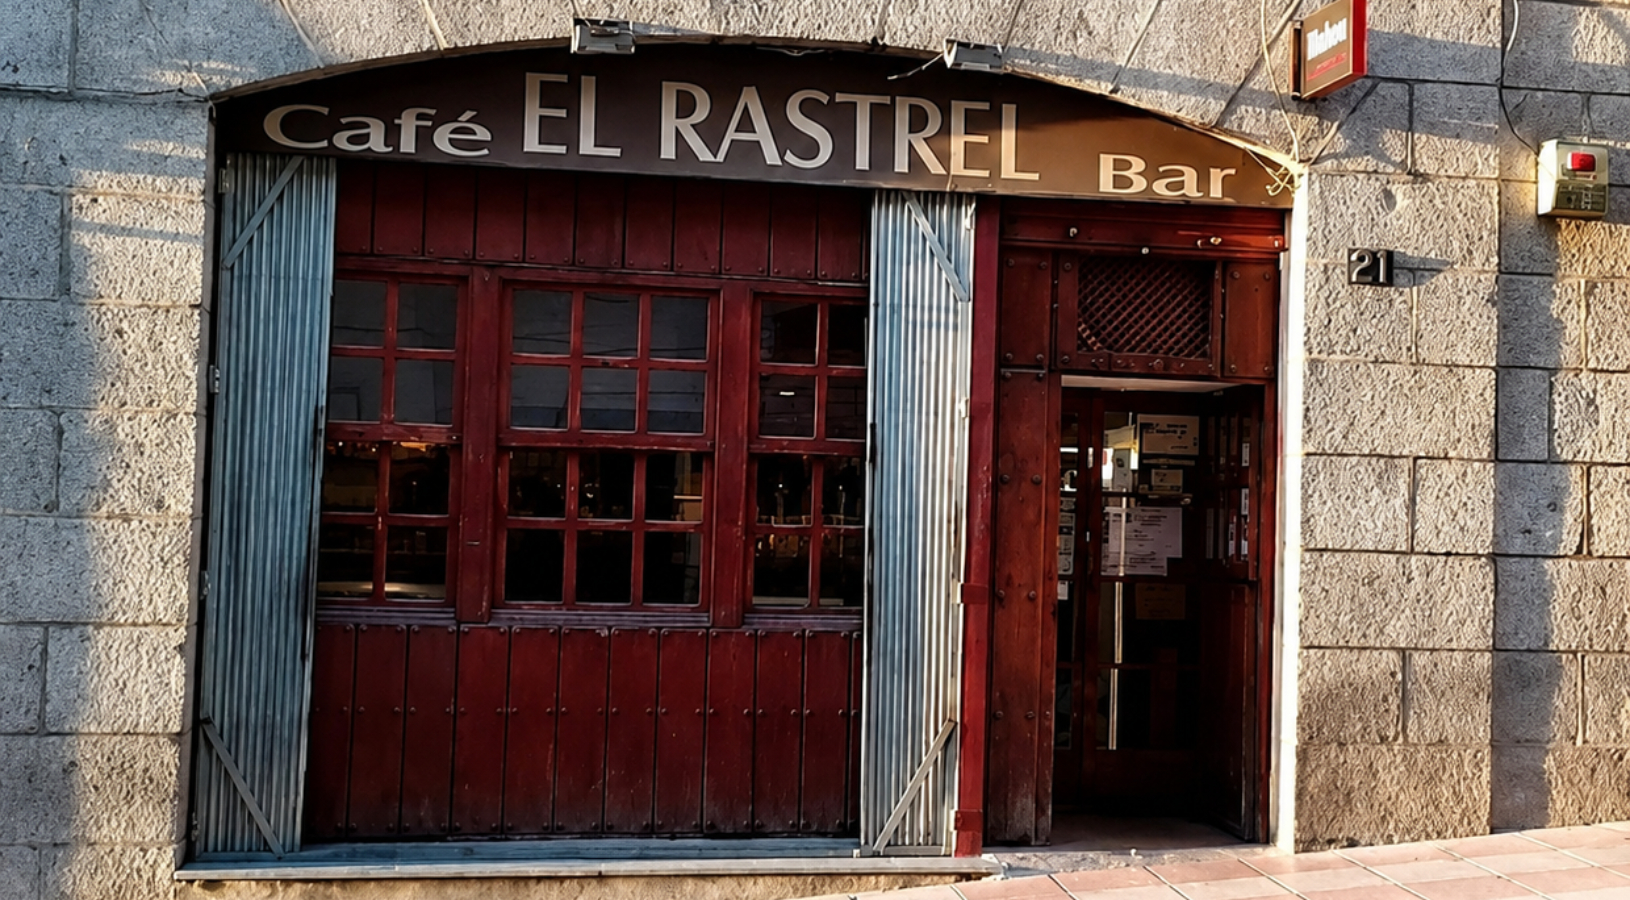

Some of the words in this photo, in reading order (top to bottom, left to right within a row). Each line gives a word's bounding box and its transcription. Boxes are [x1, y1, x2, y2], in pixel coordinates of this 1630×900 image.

[262, 104, 492, 157] Café
[522, 71, 622, 157] EL
[659, 80, 1040, 181] RASTREL
[1098, 153, 1237, 198] Bar
[1350, 249, 1388, 284] 21
